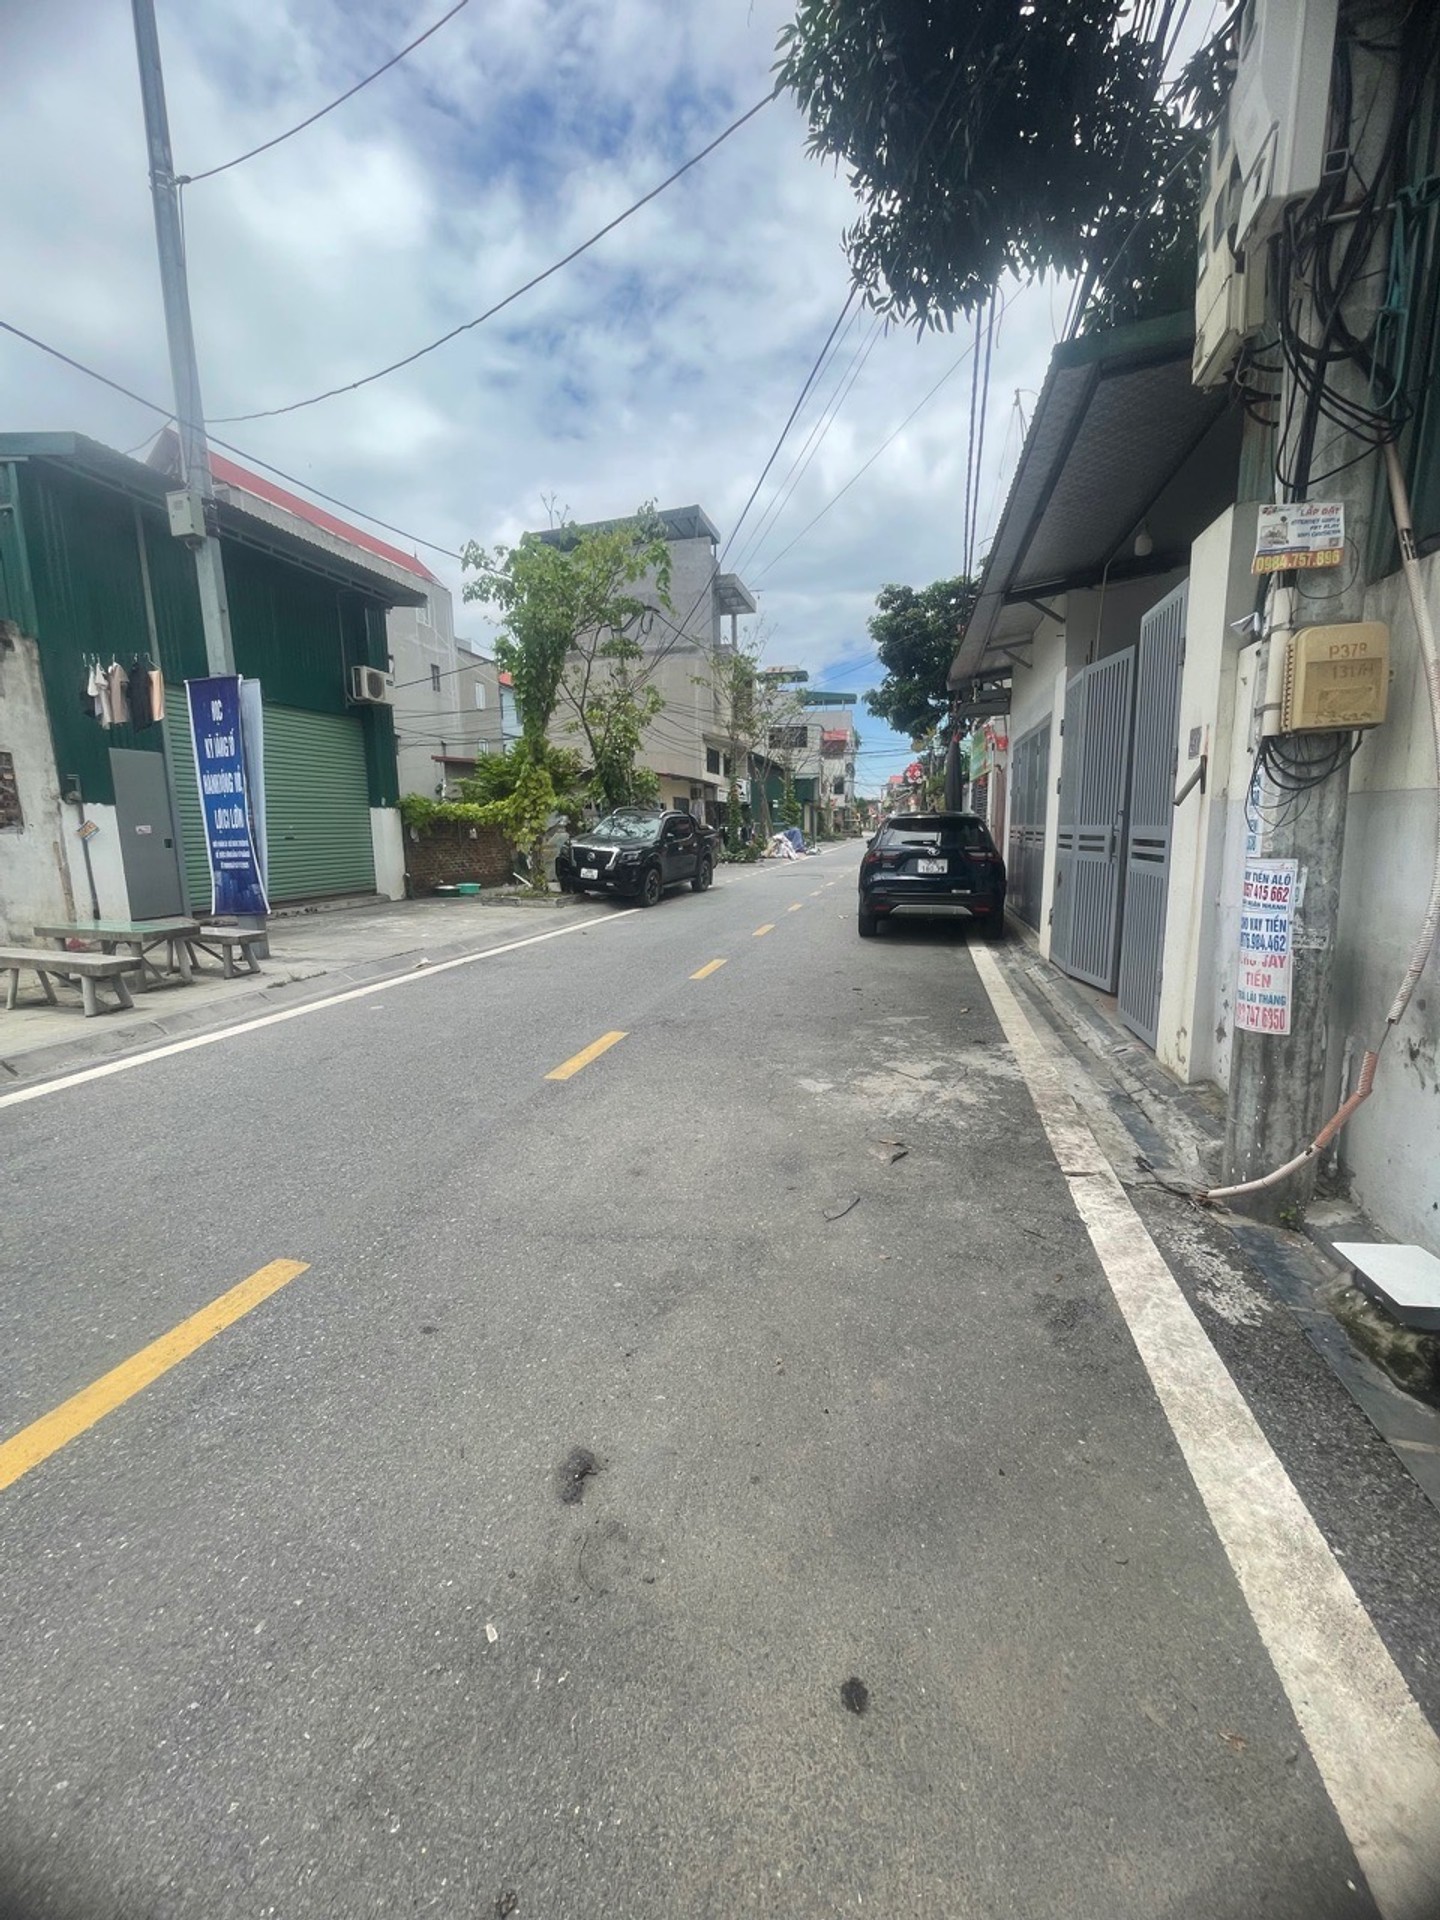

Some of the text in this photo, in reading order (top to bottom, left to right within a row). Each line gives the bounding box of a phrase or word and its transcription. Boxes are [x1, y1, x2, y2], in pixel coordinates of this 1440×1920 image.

[1256, 550, 1340, 572] 0984.757.896
[1254, 885, 1269, 901] 415
[1270, 886, 1290, 903] 662
